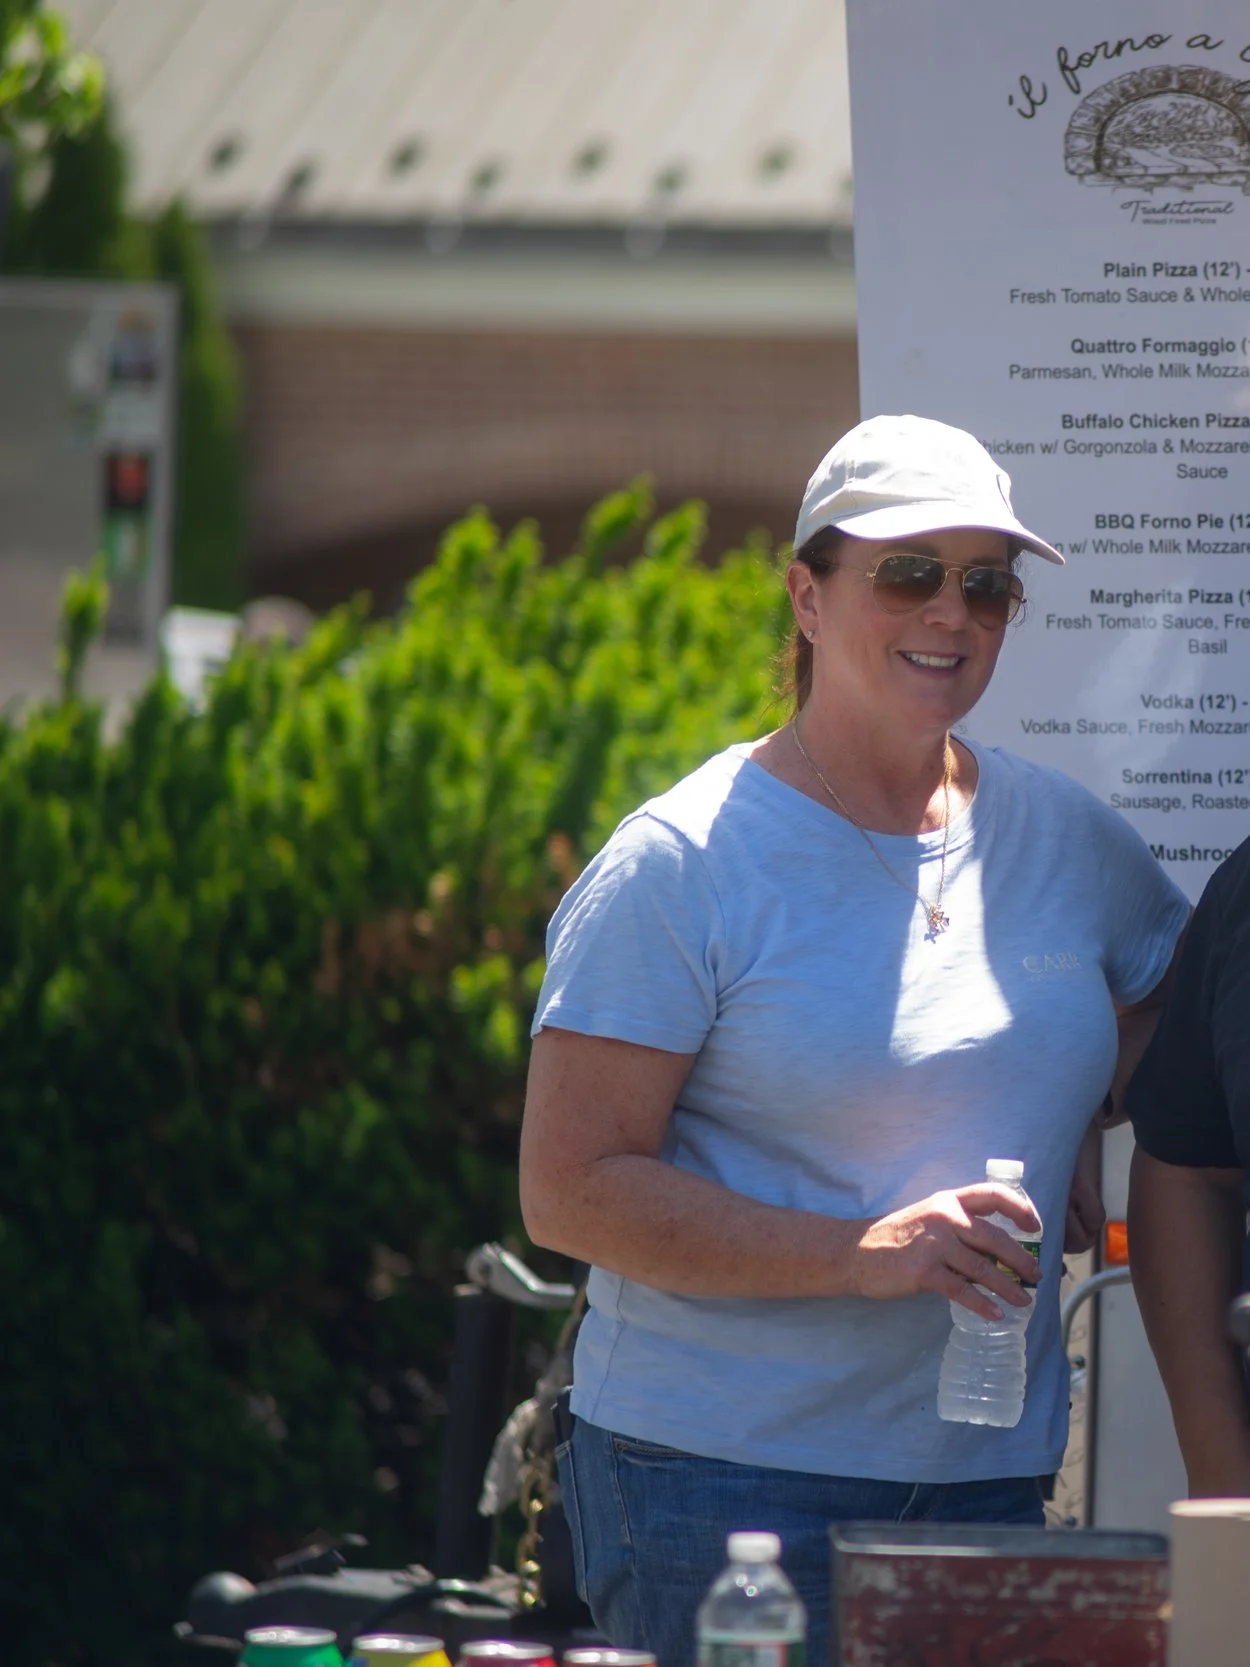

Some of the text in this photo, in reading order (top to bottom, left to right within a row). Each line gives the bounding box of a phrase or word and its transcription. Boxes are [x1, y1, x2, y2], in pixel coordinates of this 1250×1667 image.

[1057, 34, 1173, 95] forno
[1186, 34, 1224, 50] a
[1120, 200, 1235, 223] Traditional
[1103, 262, 1147, 278] Plain
[1152, 262, 1198, 277] Pizza
[1010, 289, 1056, 304] Fresh
[1061, 288, 1121, 304] Tomato
[1126, 287, 1178, 303] Sauce
[1183, 287, 1195, 303] &
[1070, 338, 1137, 354] Quattro
[1142, 337, 1236, 357] Formaggio
[1009, 364, 1097, 380] Parmesan,
[1101, 363, 1154, 379] Whole
[1159, 363, 1191, 378] Milk
[1061, 413, 1124, 430] Buffalo
[1129, 413, 1200, 429] Chicken
[1205, 413, 1250, 428] Pizza
[980, 439, 1035, 455] hicken
[1040, 439, 1058, 454] w/
[1064, 439, 1158, 458] Gorgonzola
[1162, 438, 1175, 454] &
[1177, 463, 1228, 479] Sauce
[1095, 513, 1135, 530] BBQ
[1140, 513, 1192, 529] Forno
[1197, 513, 1224, 529] Pie
[1069, 538, 1087, 554] w/
[1092, 539, 1144, 554] Whole
[1149, 539, 1182, 554] Milk
[1090, 589, 1183, 608] Margherita
[1188, 589, 1234, 604] Pizza
[1046, 614, 1092, 629] Fresh
[1097, 614, 1157, 629] Tomato
[1163, 614, 1218, 631] Sauce,
[1188, 638, 1227, 654] Basil
[1140, 693, 1194, 709] Vodka
[1021, 719, 1071, 735] Vodka
[1077, 719, 1132, 736] Sauce,
[1138, 719, 1184, 734] Fresh
[1122, 769, 1213, 784] Sorrentina
[1111, 794, 1186, 812] Sausage,
